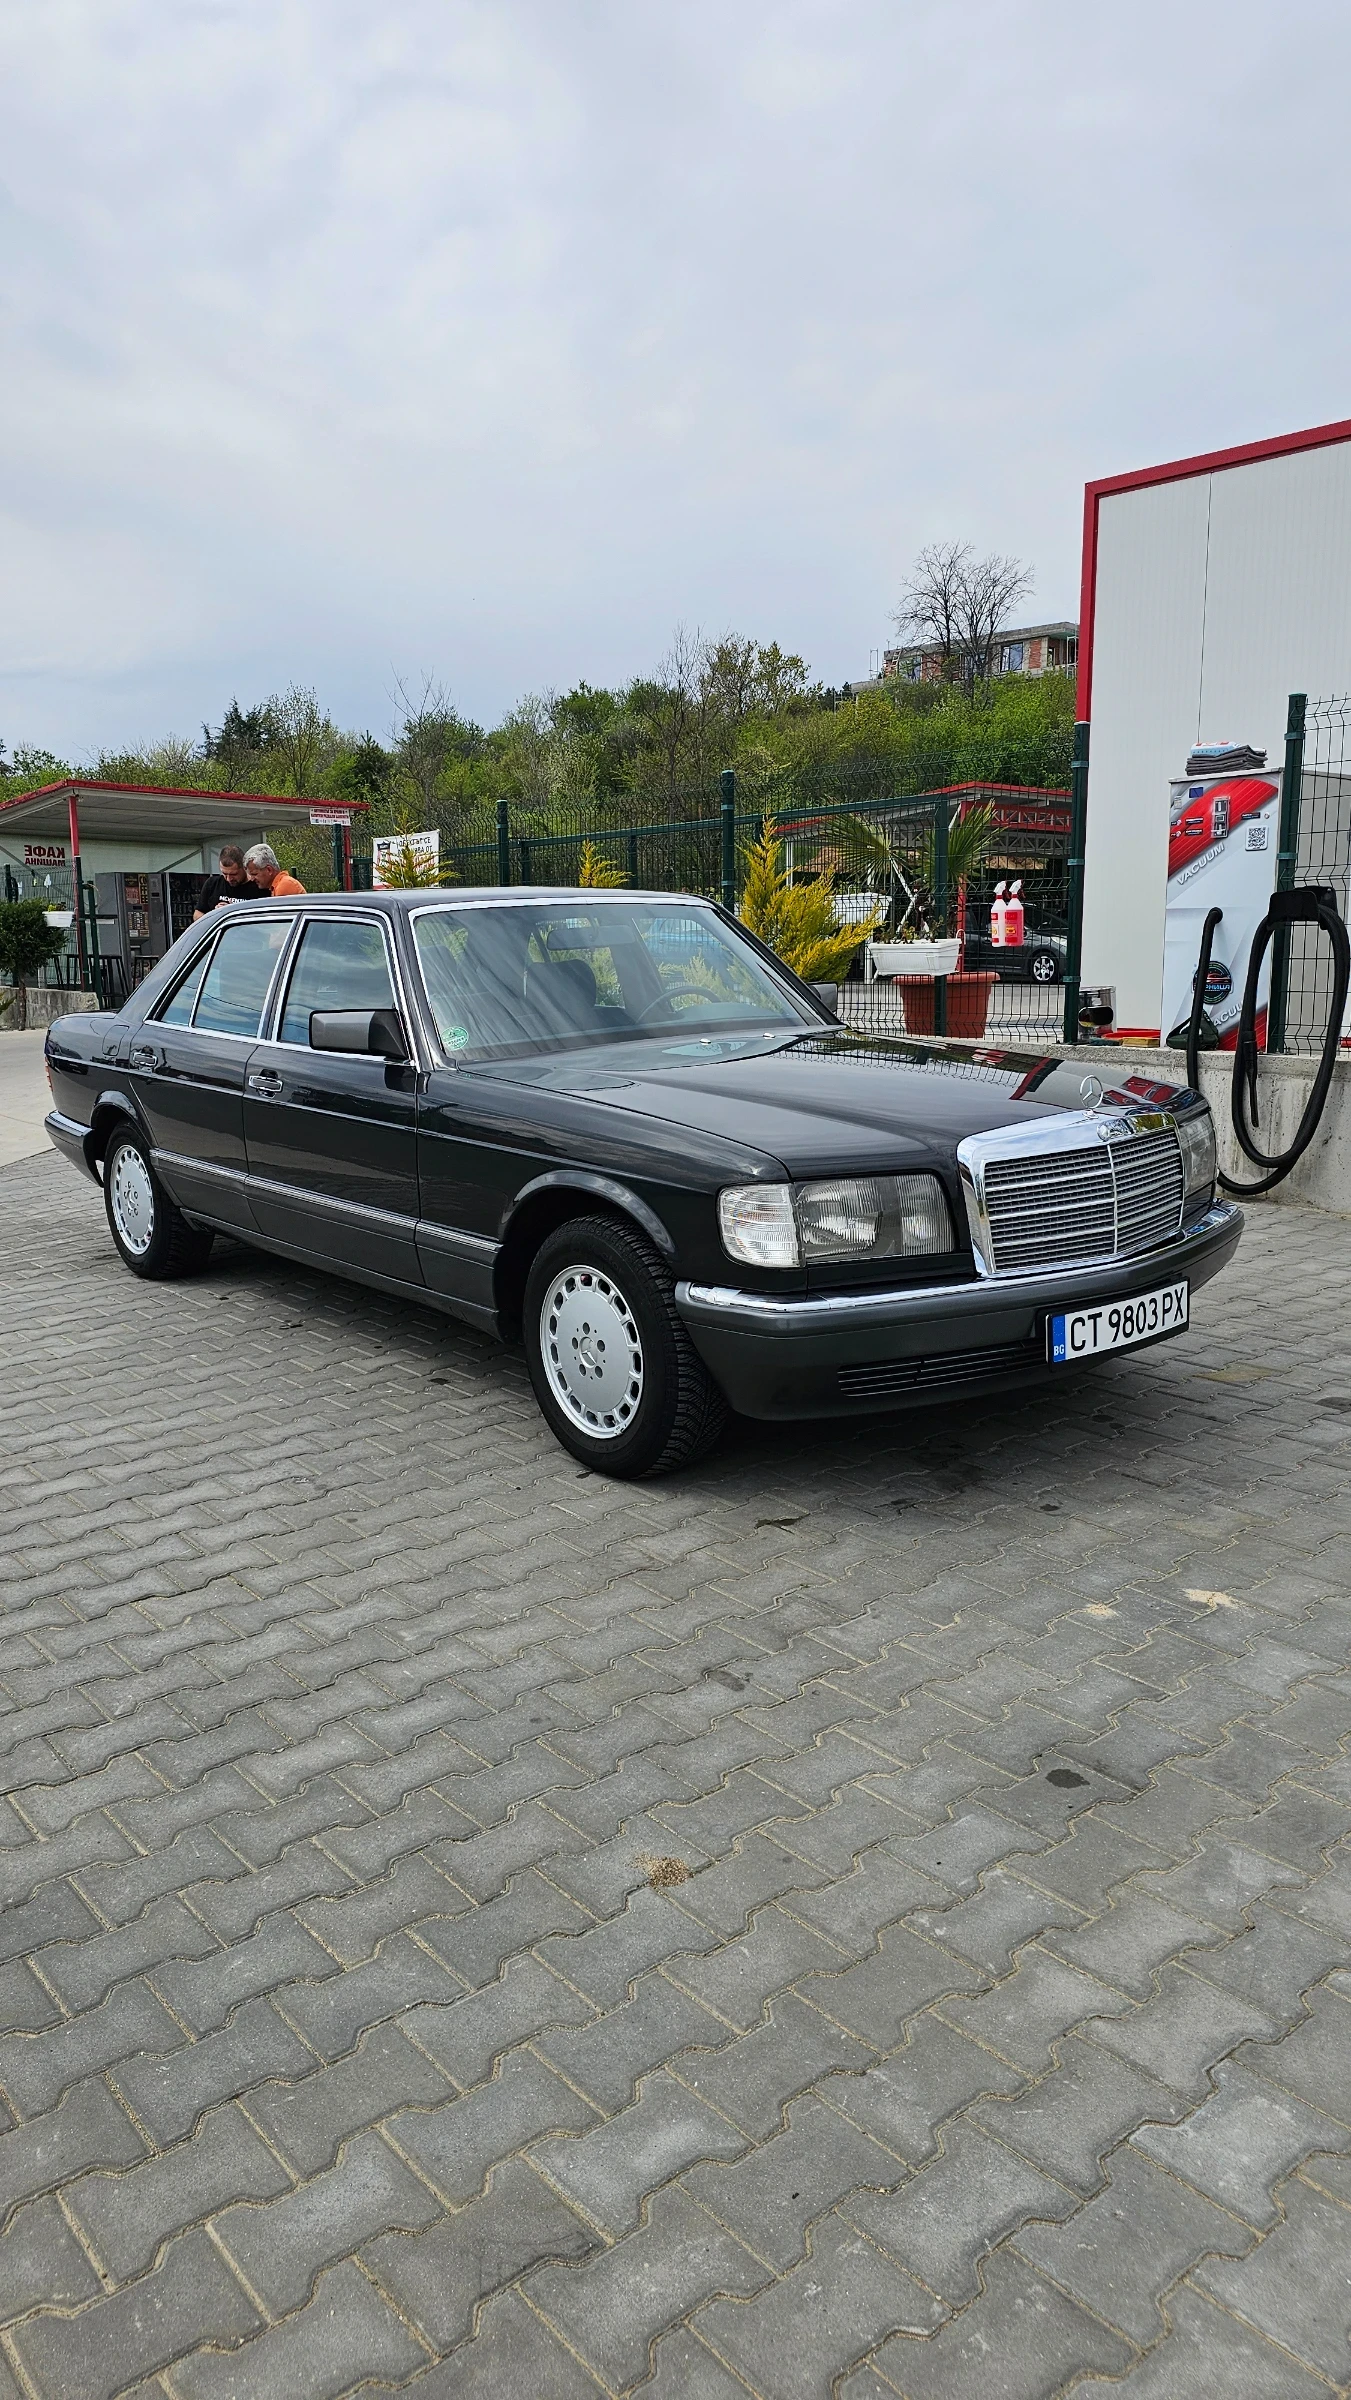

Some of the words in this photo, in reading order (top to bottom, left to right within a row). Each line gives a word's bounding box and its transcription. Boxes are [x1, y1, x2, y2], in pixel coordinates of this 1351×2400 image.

[1177, 842, 1225, 885] VACUUM
[1213, 1002, 1243, 1027] ACUU
[1053, 1344, 1065, 1356] BG
